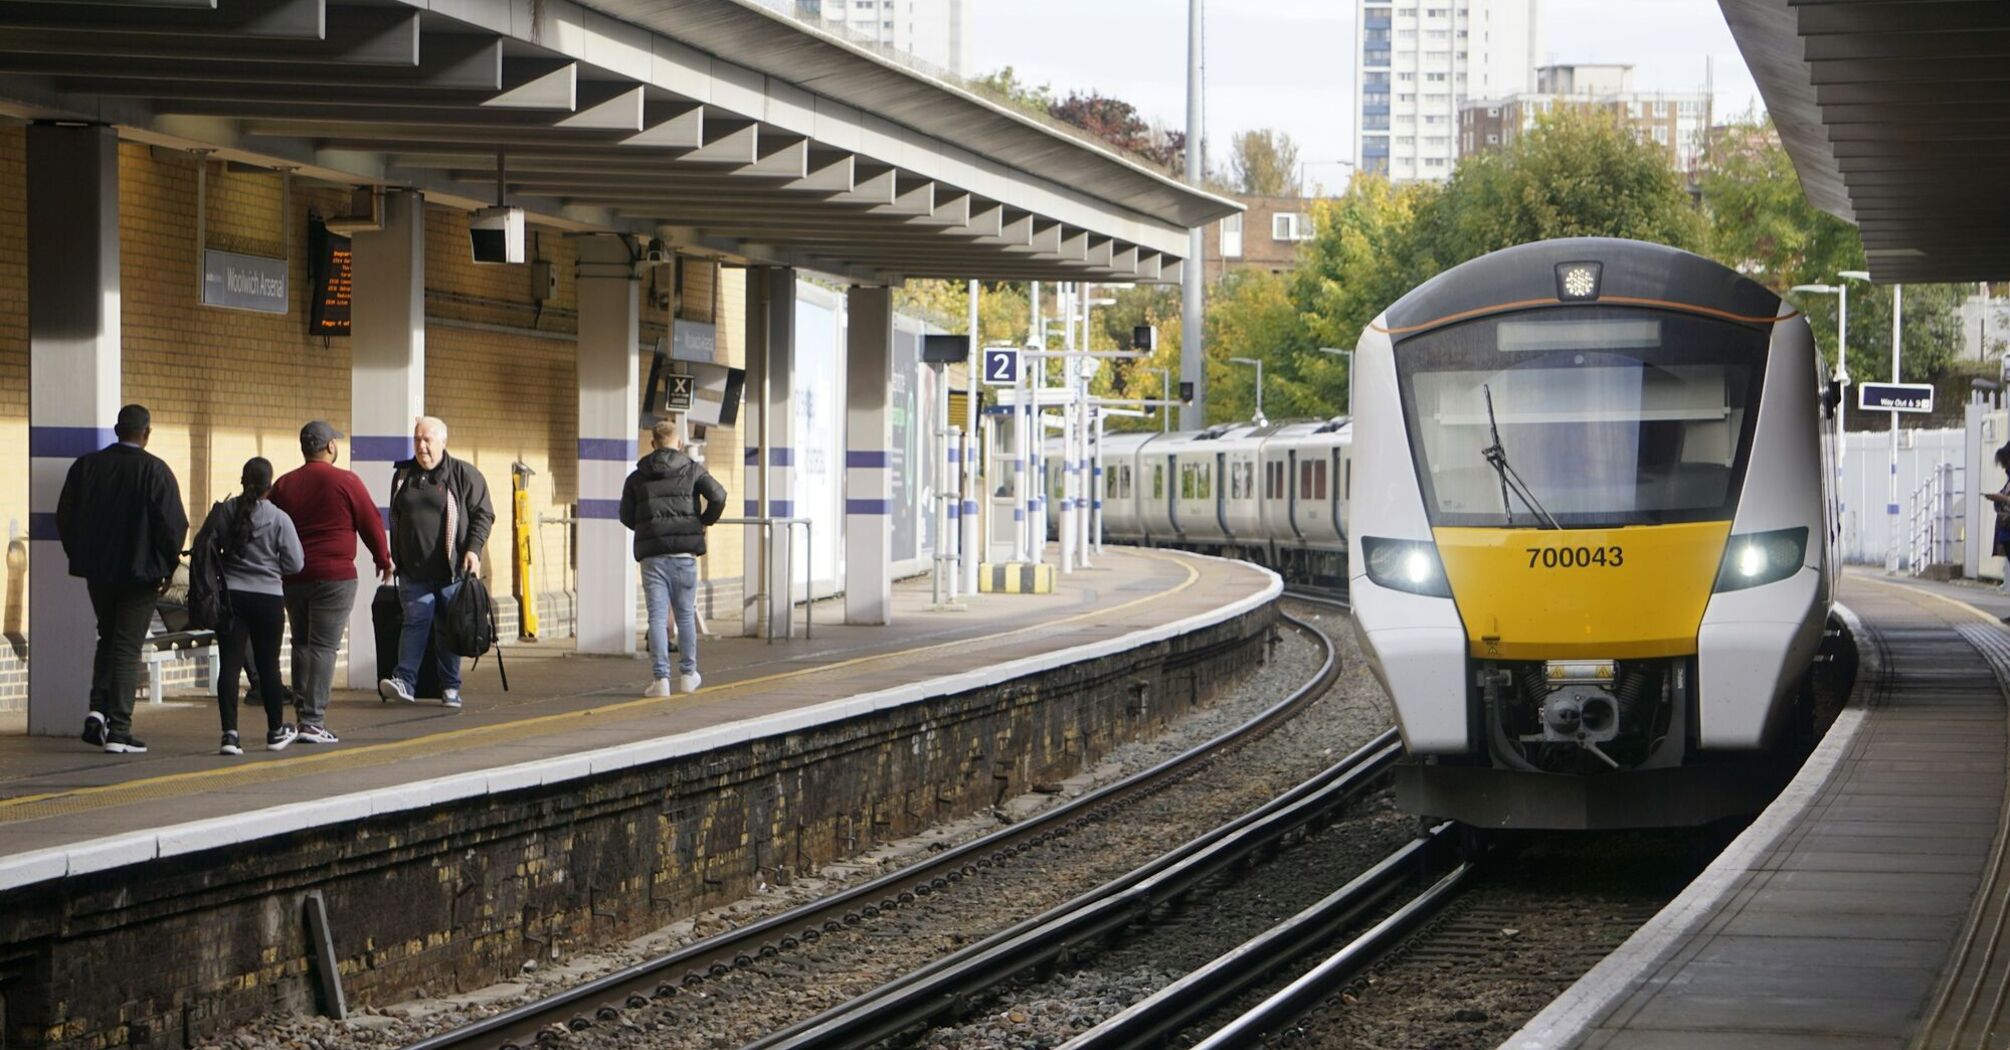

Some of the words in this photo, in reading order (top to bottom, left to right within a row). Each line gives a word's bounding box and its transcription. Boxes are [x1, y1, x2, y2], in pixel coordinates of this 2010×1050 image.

[227, 266, 259, 296] Woolwich
[260, 271, 285, 298] Arsenal
[993, 353, 1010, 379] 2
[674, 378, 687, 393] X
[1880, 398, 1894, 408] Way
[1894, 398, 1907, 407] Out
[1526, 546, 1624, 568] 700043
